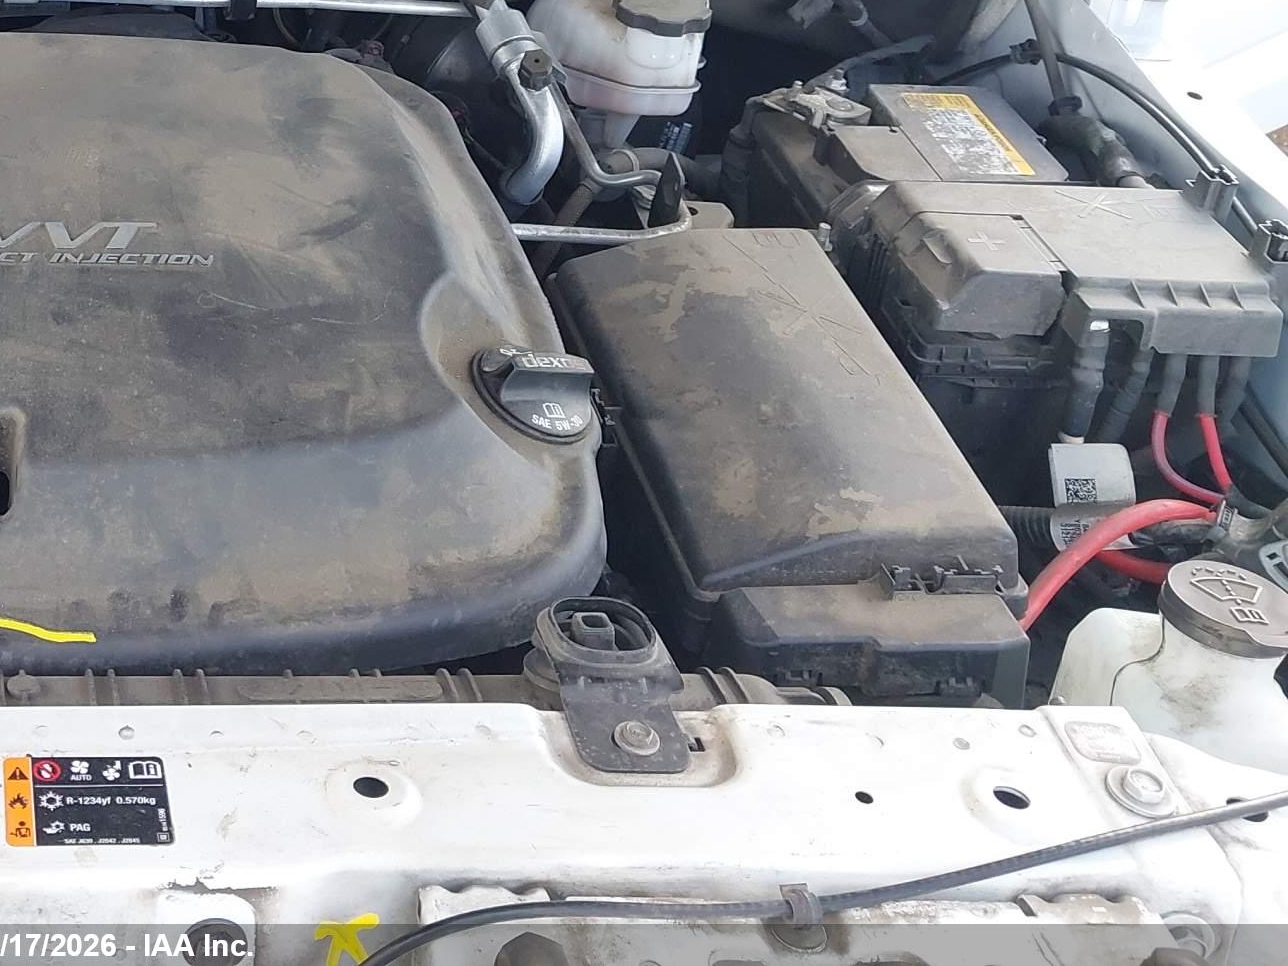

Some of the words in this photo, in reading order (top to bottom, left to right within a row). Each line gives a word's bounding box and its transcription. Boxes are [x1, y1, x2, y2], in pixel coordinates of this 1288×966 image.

[49, 252, 214, 267] INJECTION
[532, 414, 553, 429] SAE
[555, 415, 582, 430] 5W-30
[66, 796, 111, 806] R-1234yf
[116, 797, 156, 806] 0.570kg
[70, 823, 91, 832] PAG
